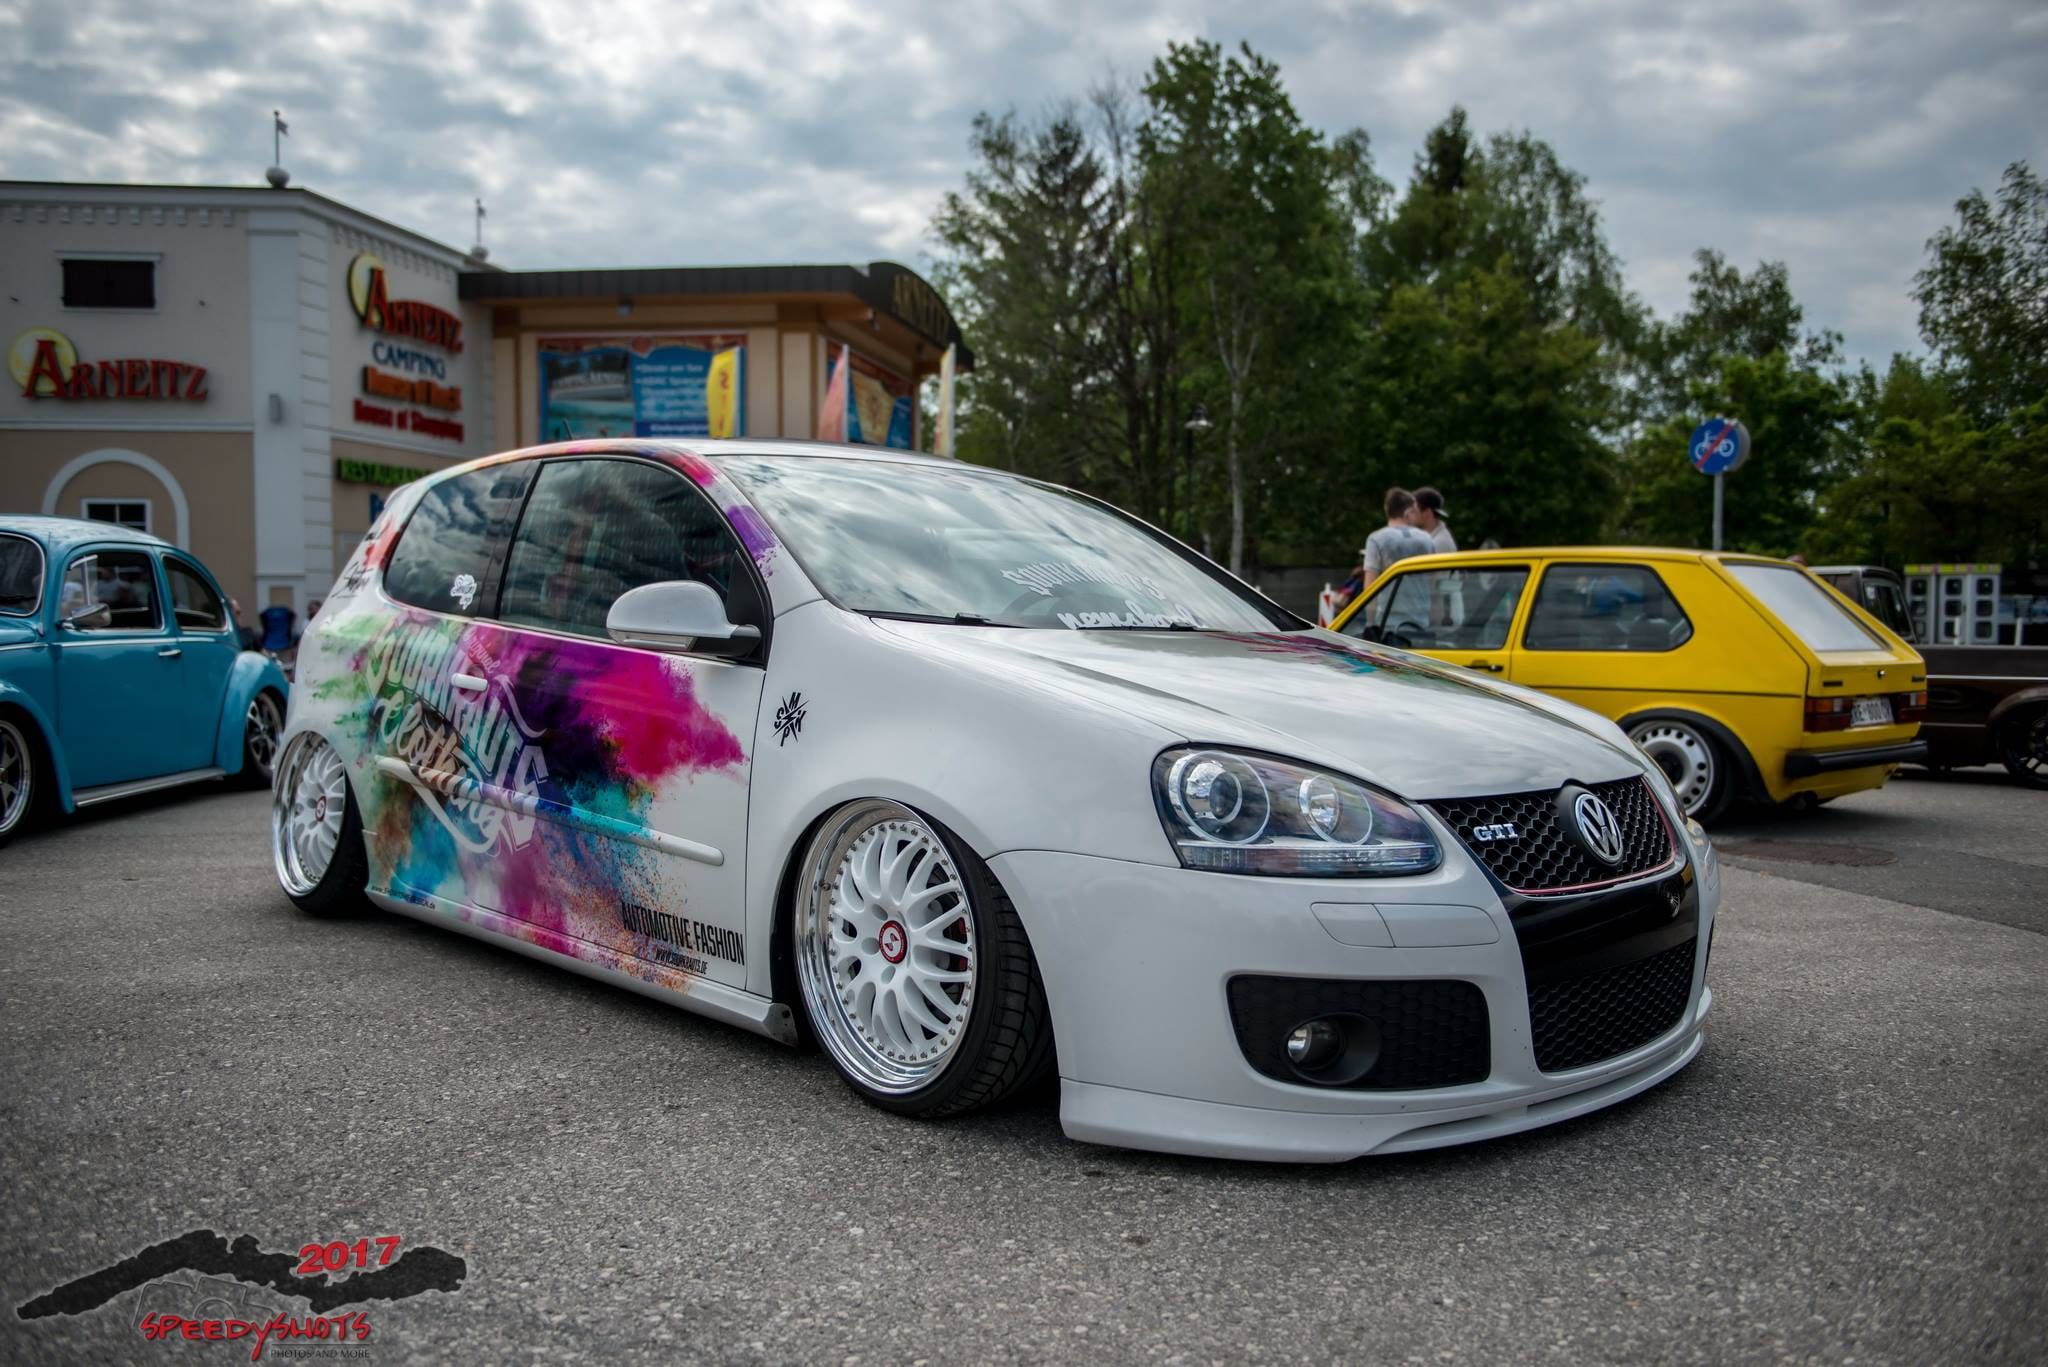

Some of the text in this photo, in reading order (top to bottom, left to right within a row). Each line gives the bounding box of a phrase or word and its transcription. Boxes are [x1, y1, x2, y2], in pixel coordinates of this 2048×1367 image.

[362, 267, 464, 352] ARNEITZ
[21, 339, 209, 401] ARNEITZ
[371, 341, 446, 381] CAMPING
[1473, 823, 1519, 842] GTI
[620, 901, 746, 967] AUTOMOTIVE FASHION
